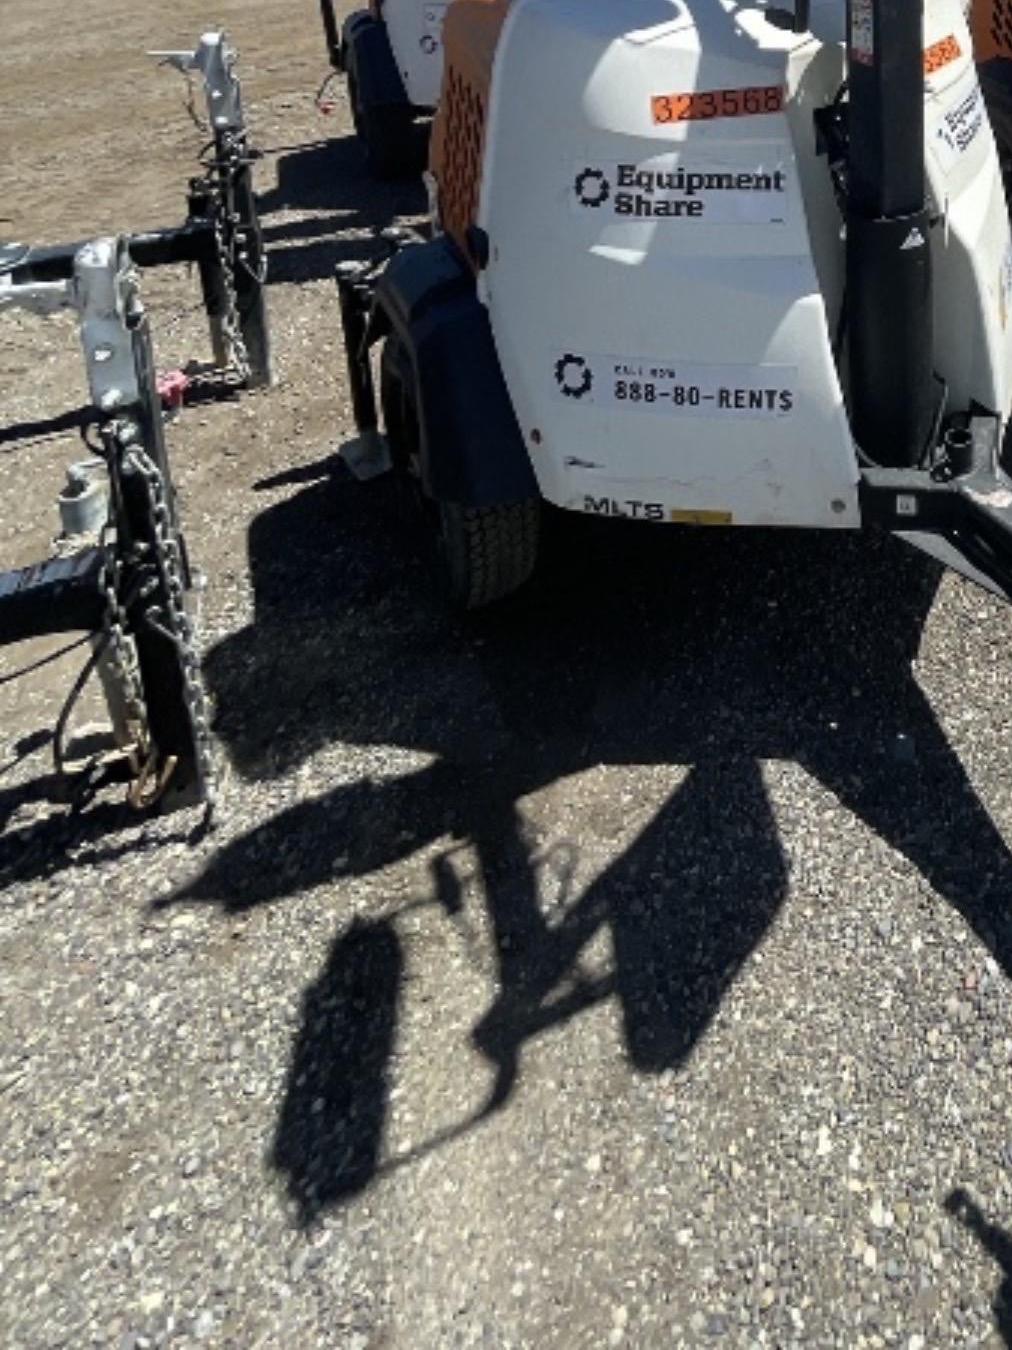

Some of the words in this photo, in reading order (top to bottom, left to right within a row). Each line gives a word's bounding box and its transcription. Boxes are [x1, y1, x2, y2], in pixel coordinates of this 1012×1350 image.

[653, 87, 783, 123] 323568
[616, 164, 785, 195] Equipment
[614, 192, 703, 216] Share
[614, 380, 793, 412] 888-80-RENTS
[584, 494, 665, 521] MLTS
